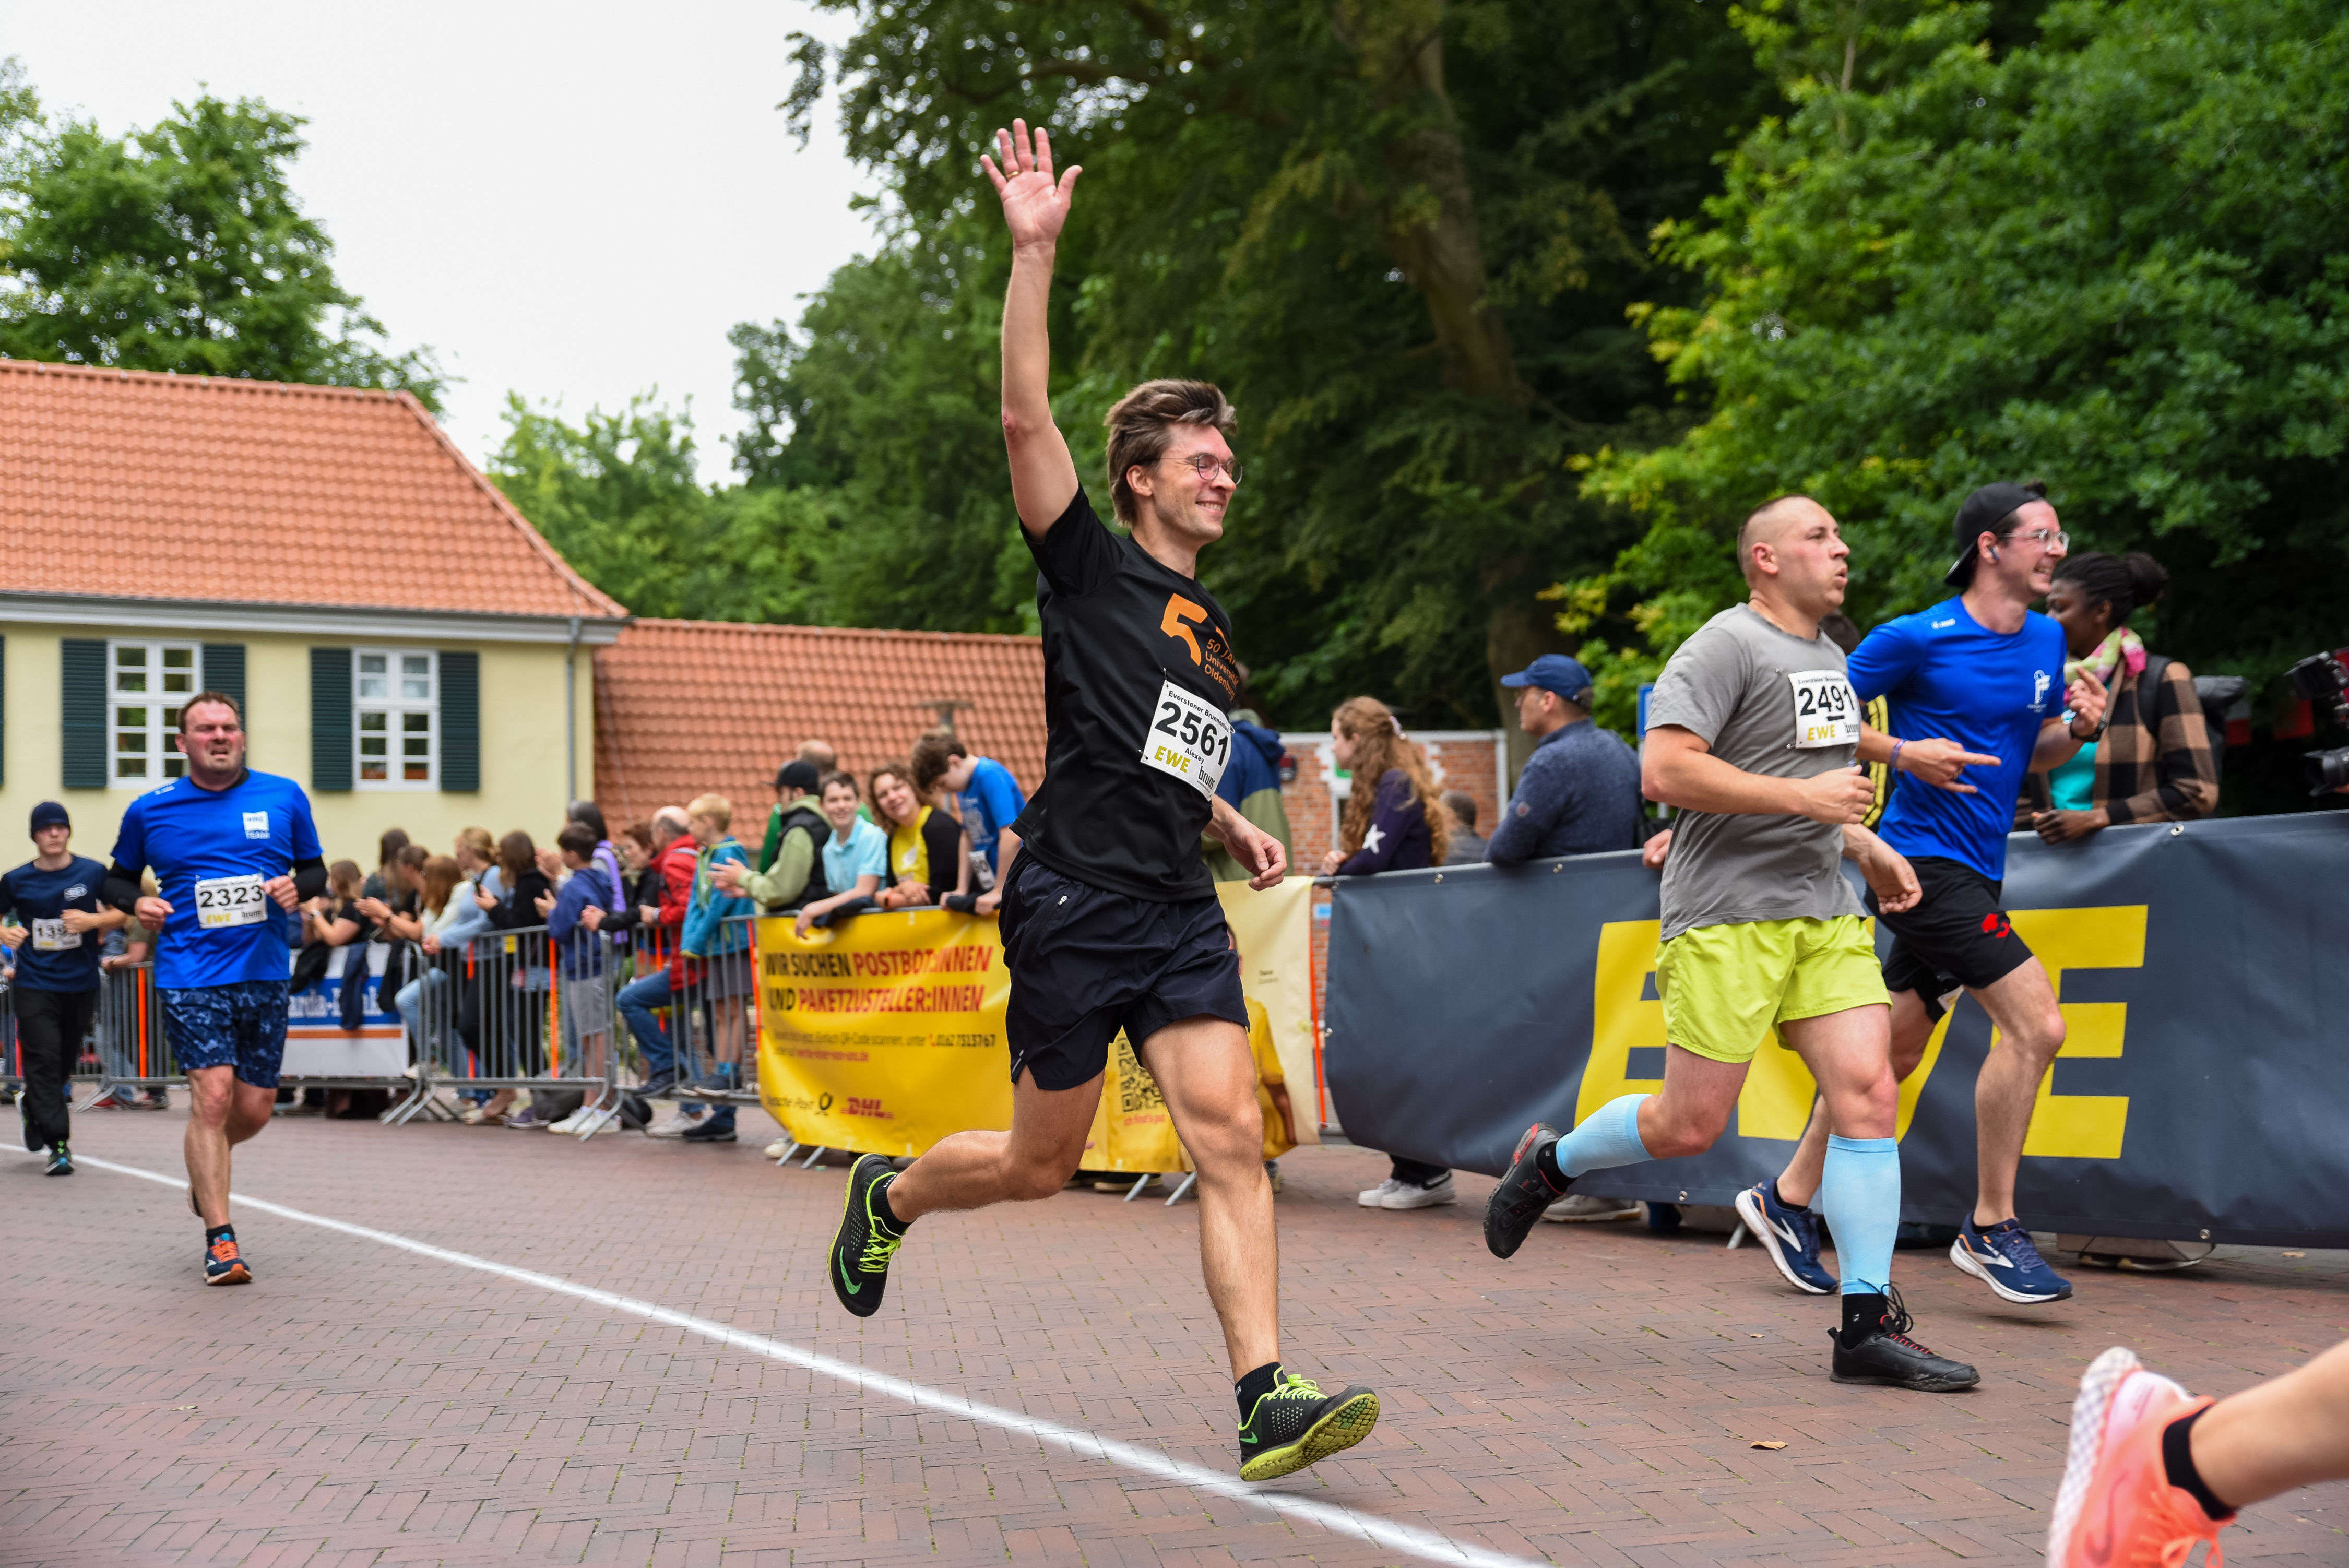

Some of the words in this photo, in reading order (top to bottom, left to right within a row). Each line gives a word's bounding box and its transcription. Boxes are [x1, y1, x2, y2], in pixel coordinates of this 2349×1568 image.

[1206, 639, 1221, 652] 50
[1205, 651, 1239, 688] Universität
[1205, 664, 1235, 701] Oldenburg
[1168, 691, 1204, 713] Everstener
[1798, 685, 1855, 716] 2491
[1154, 701, 1229, 767] 2561
[1807, 724, 1836, 741] EWE
[1154, 745, 1191, 773] EWE
[1184, 747, 1205, 764] Alexey
[1198, 765, 1215, 790] bruns
[199, 885, 263, 907] 2323
[791, 953, 851, 977] SUCHEN
[769, 987, 796, 1011] UND
[798, 984, 986, 1013] PAKETZUSTELLER:INNEN
[846, 1096, 886, 1118] DHL
